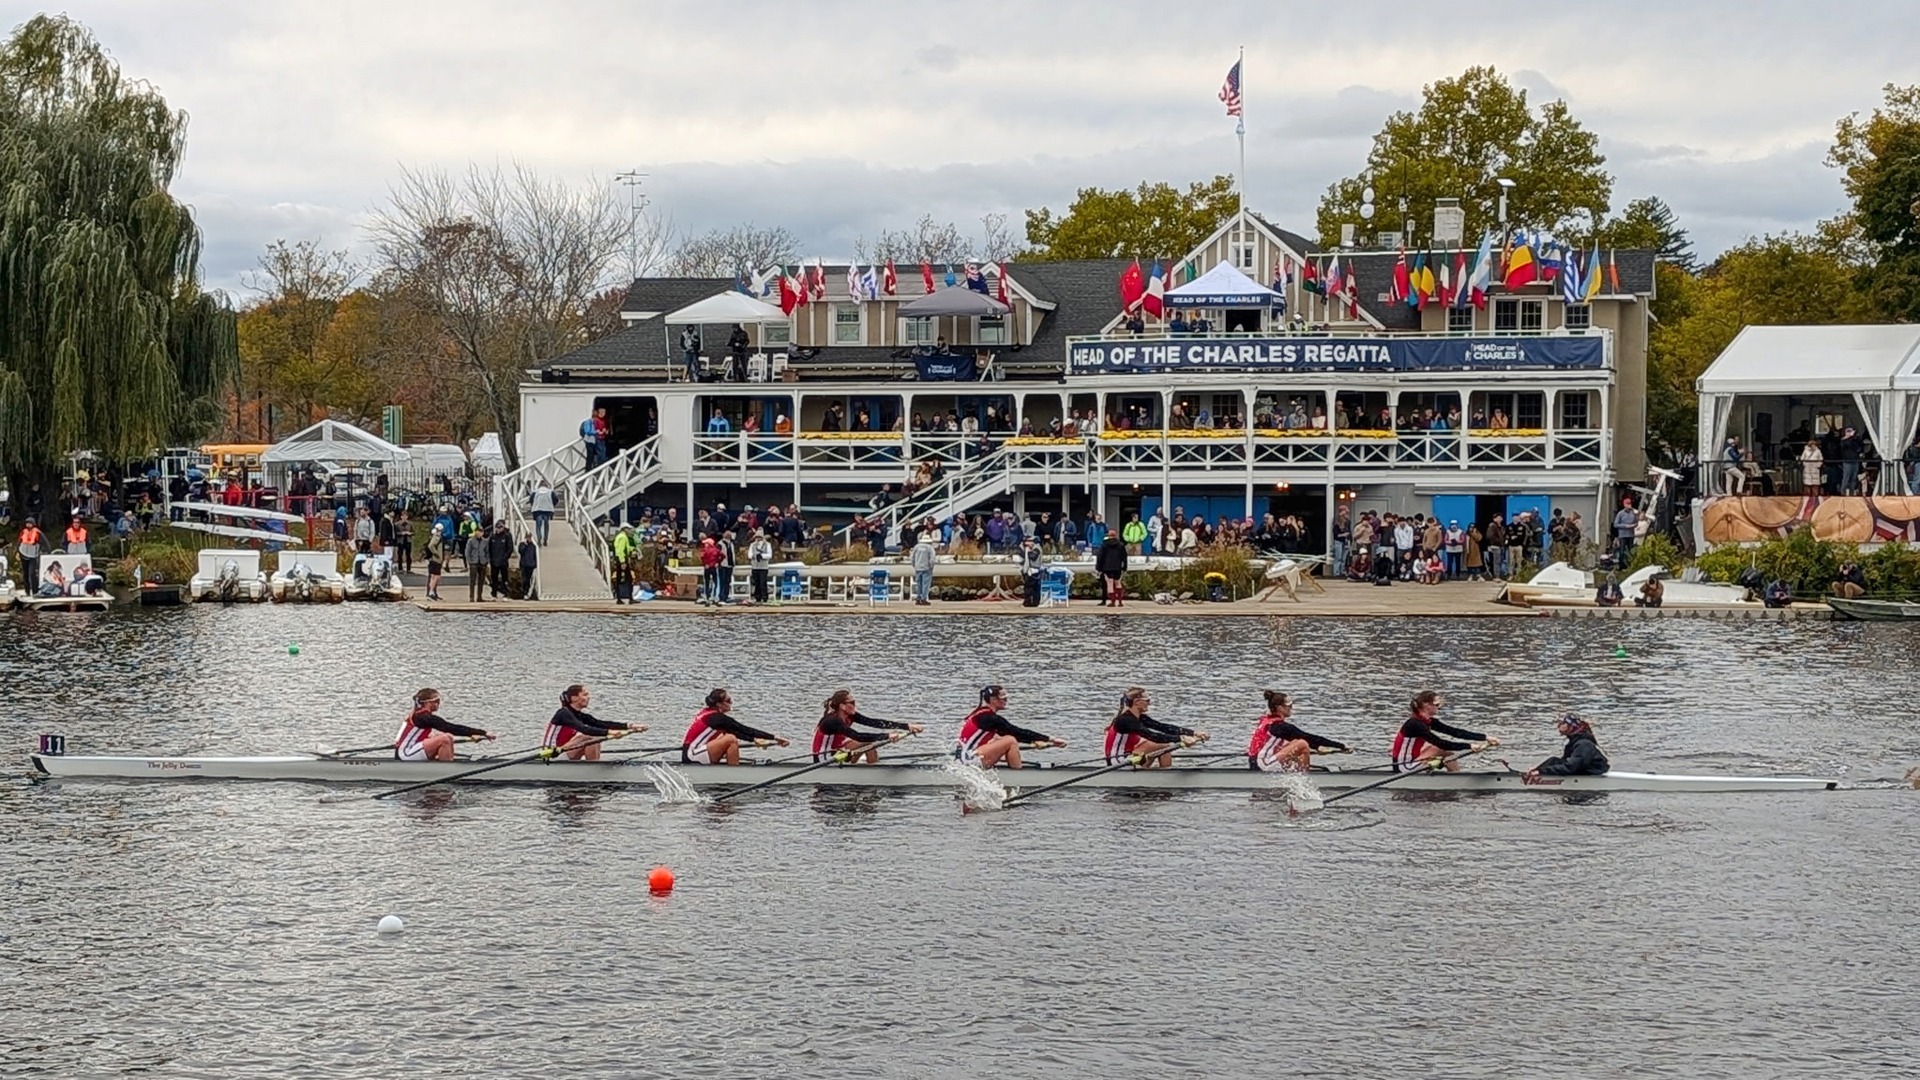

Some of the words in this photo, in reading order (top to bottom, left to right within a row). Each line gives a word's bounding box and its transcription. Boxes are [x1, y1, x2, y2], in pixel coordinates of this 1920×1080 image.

[1473, 344, 1496, 352] HEAD
[1073, 347, 1105, 366] HEAD
[1110, 346, 1136, 365] OF
[1141, 345, 1181, 364] THE
[1304, 344, 1391, 363] REGATTA
[1473, 351, 1517, 360] CHARLES
[46, 736, 62, 753] 11
